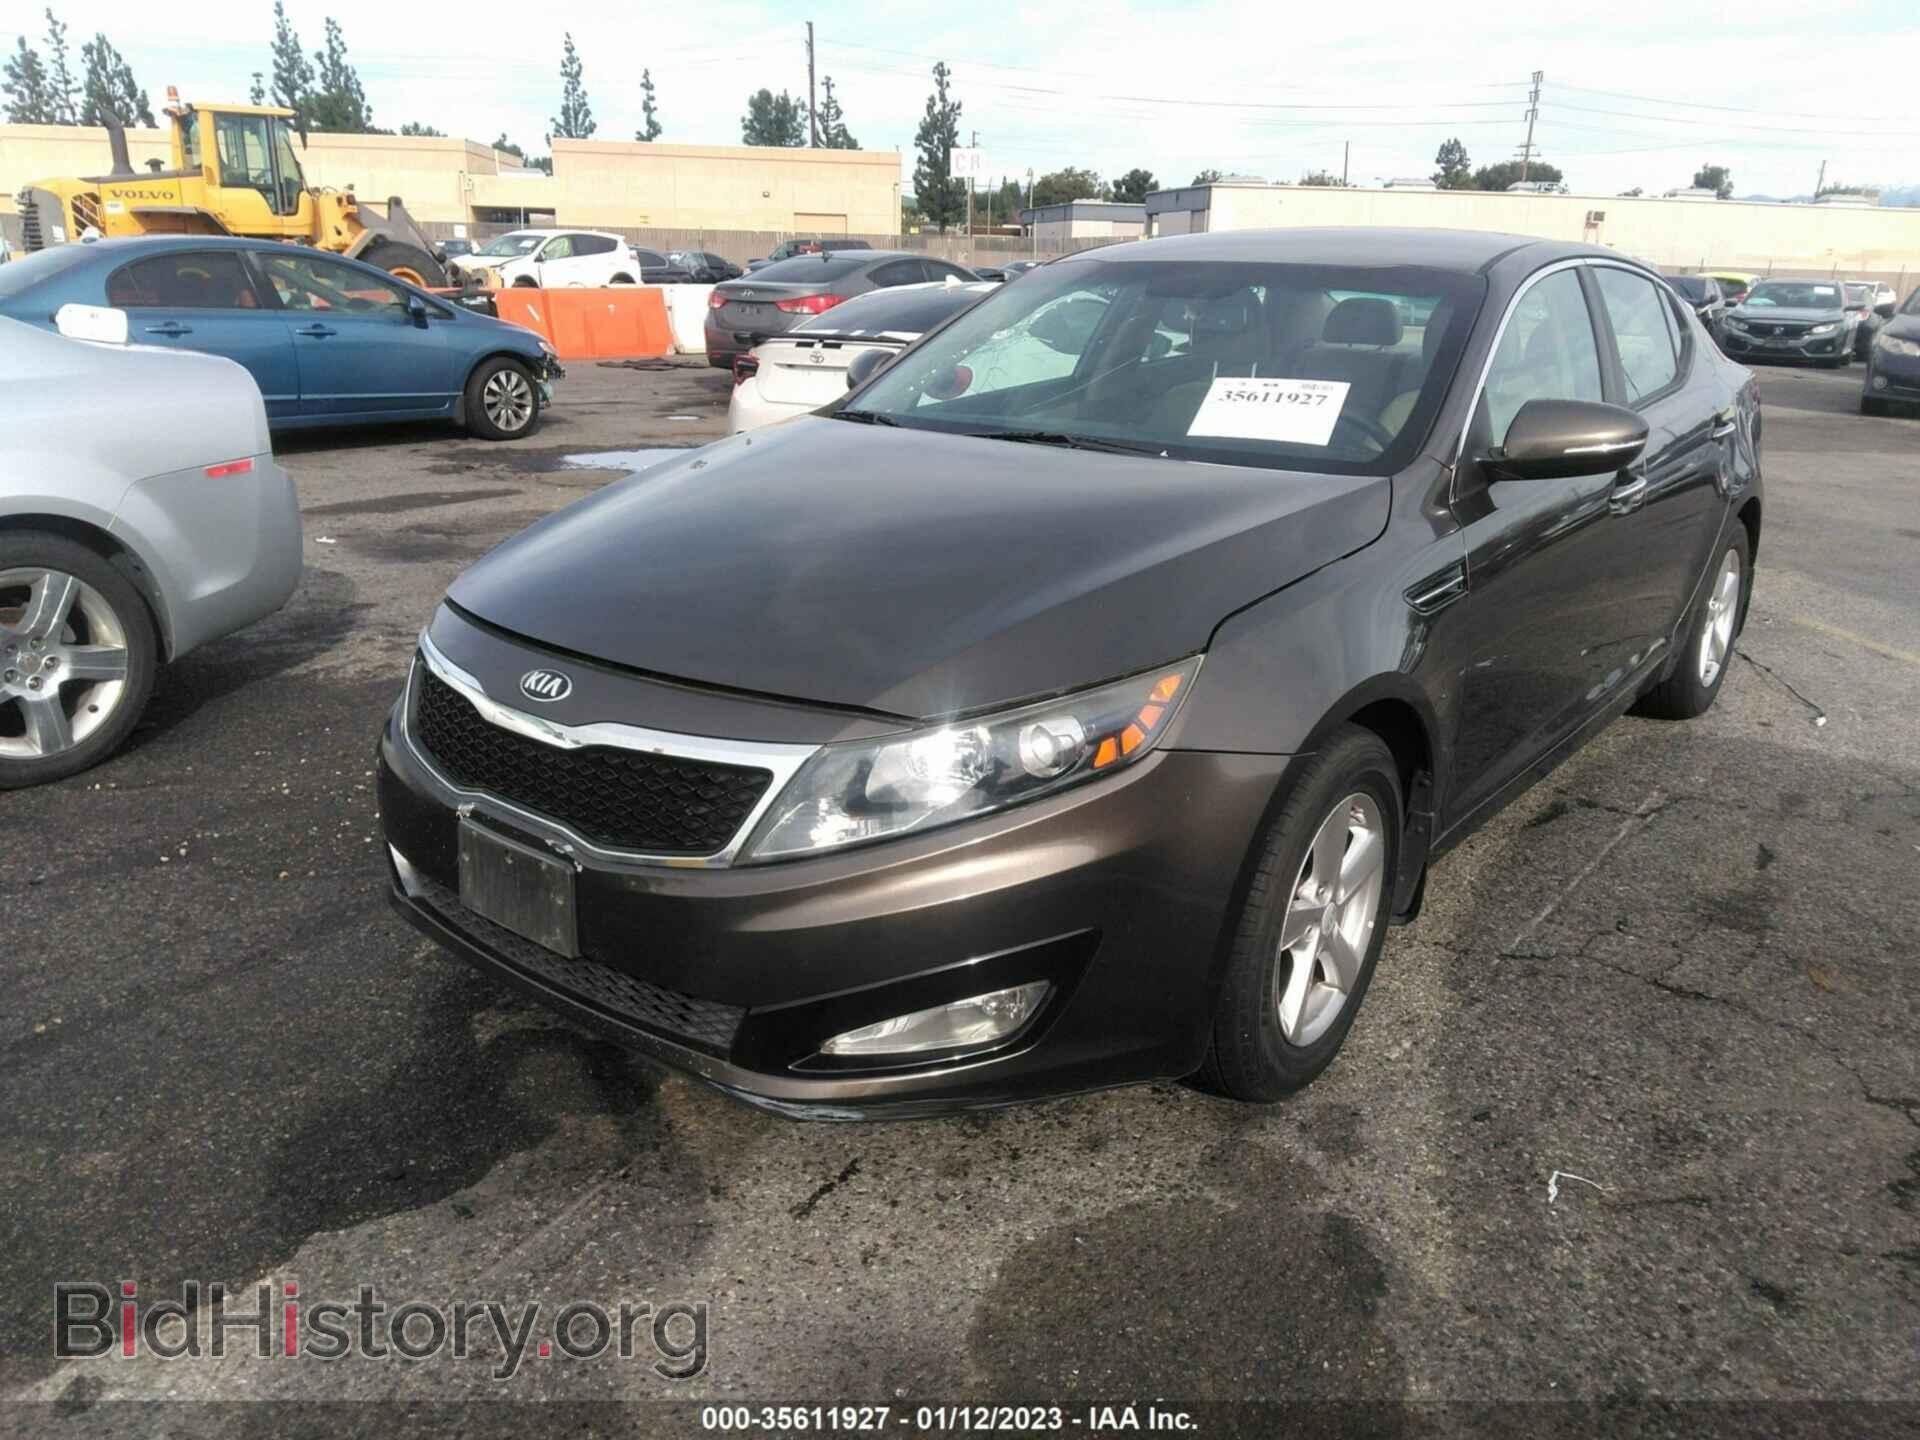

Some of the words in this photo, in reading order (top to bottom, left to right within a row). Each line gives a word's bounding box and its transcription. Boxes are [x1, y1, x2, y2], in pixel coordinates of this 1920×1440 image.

[111, 190, 174, 200] VOLVO
[1218, 390, 1328, 406] 35611927
[524, 671, 562, 697] KIA
